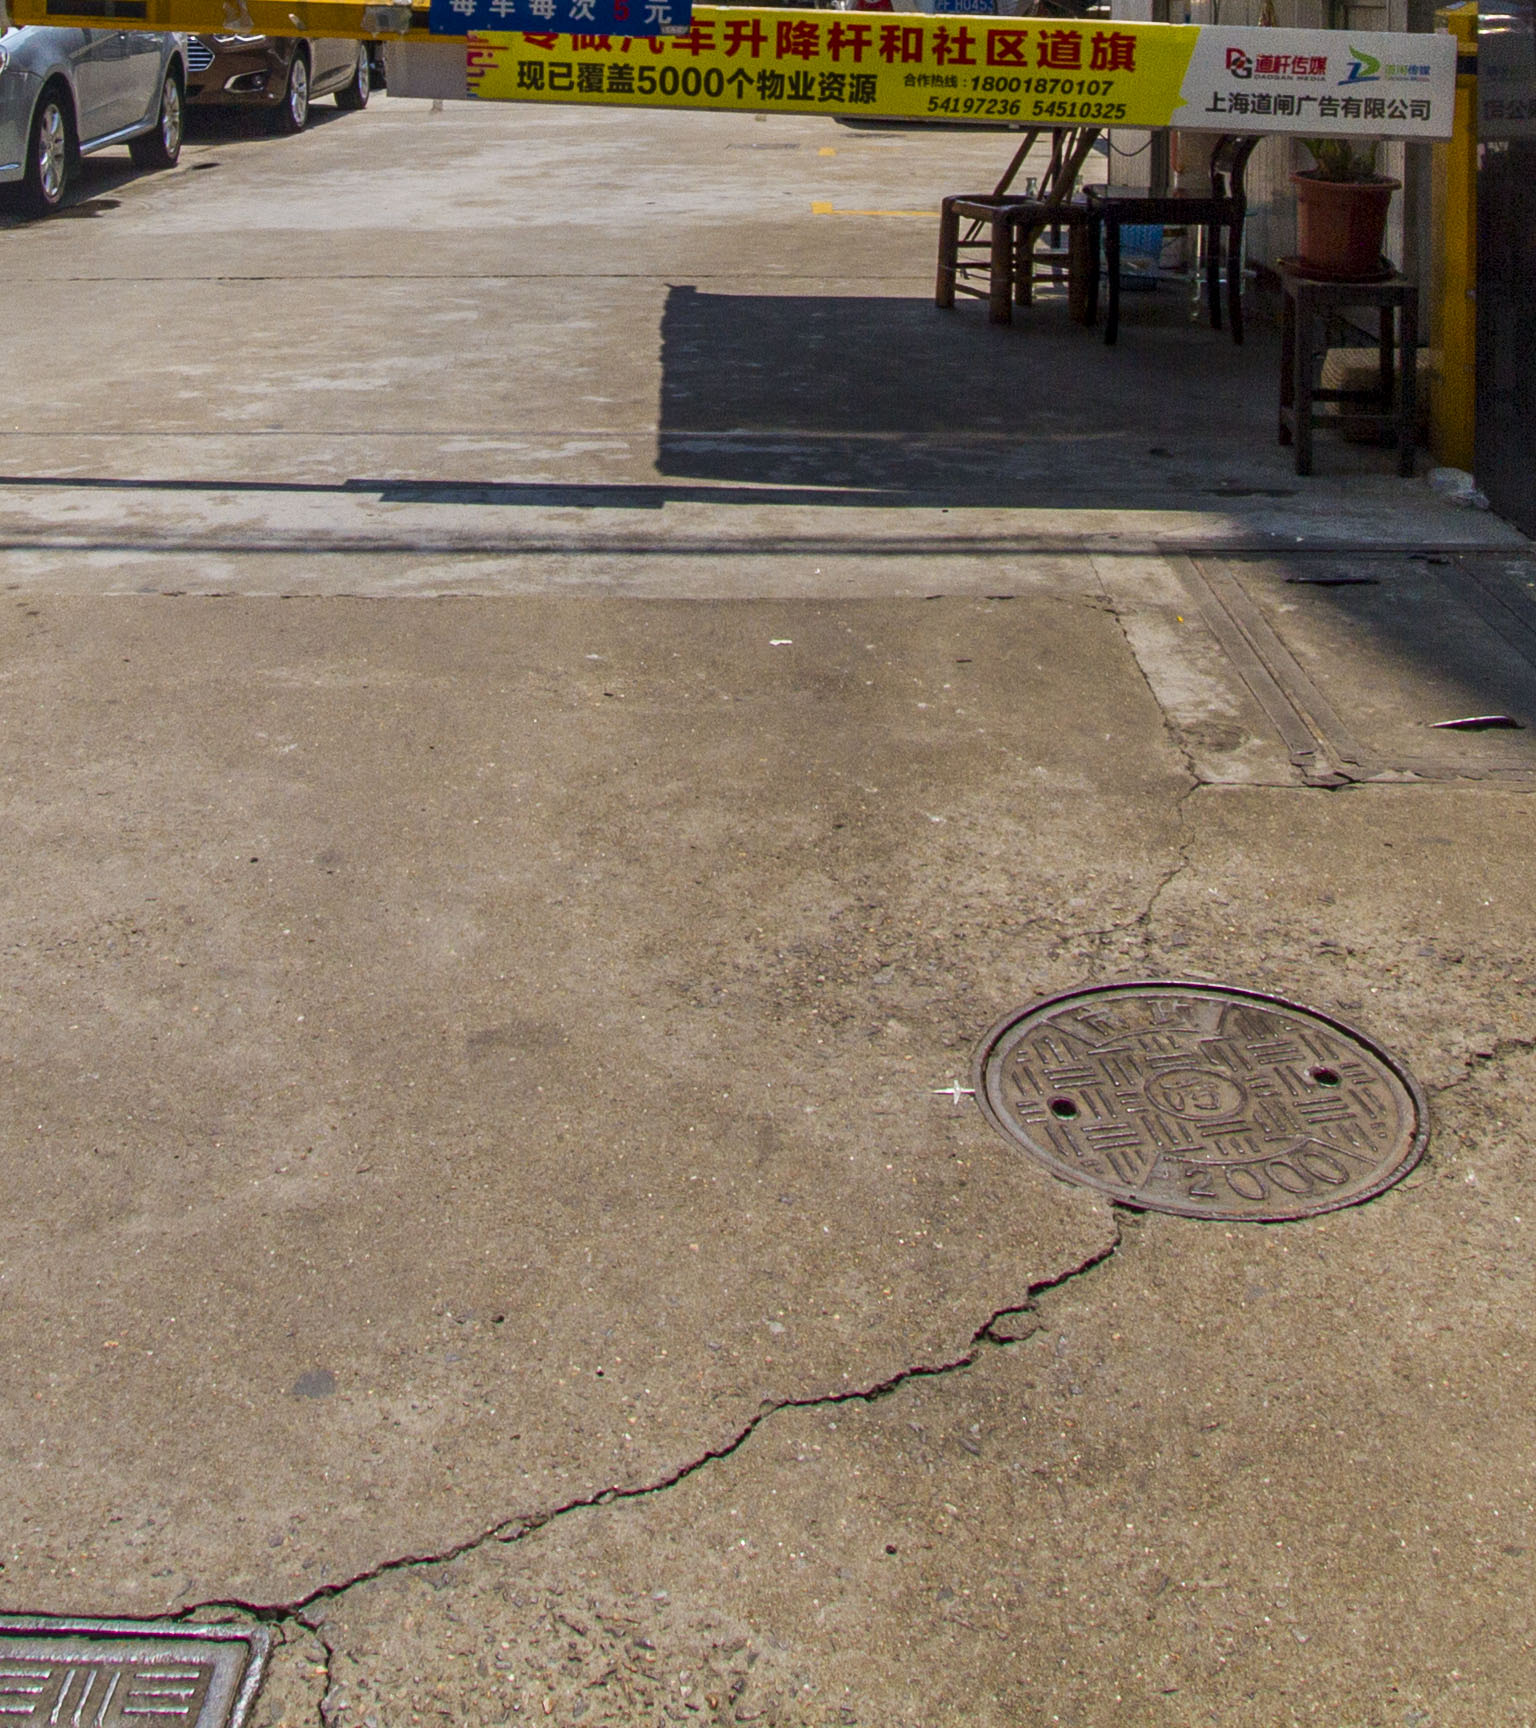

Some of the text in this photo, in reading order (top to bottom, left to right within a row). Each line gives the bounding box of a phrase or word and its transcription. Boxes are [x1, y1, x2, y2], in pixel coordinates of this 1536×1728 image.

[516, 60, 878, 105] 现已覆盖5000个物业资源
[927, 96, 1127, 120] 54197236 54510325
[1205, 91, 1432, 121] 上海道闸广告有限公司
[1184, 1149, 1352, 1201] 2000
